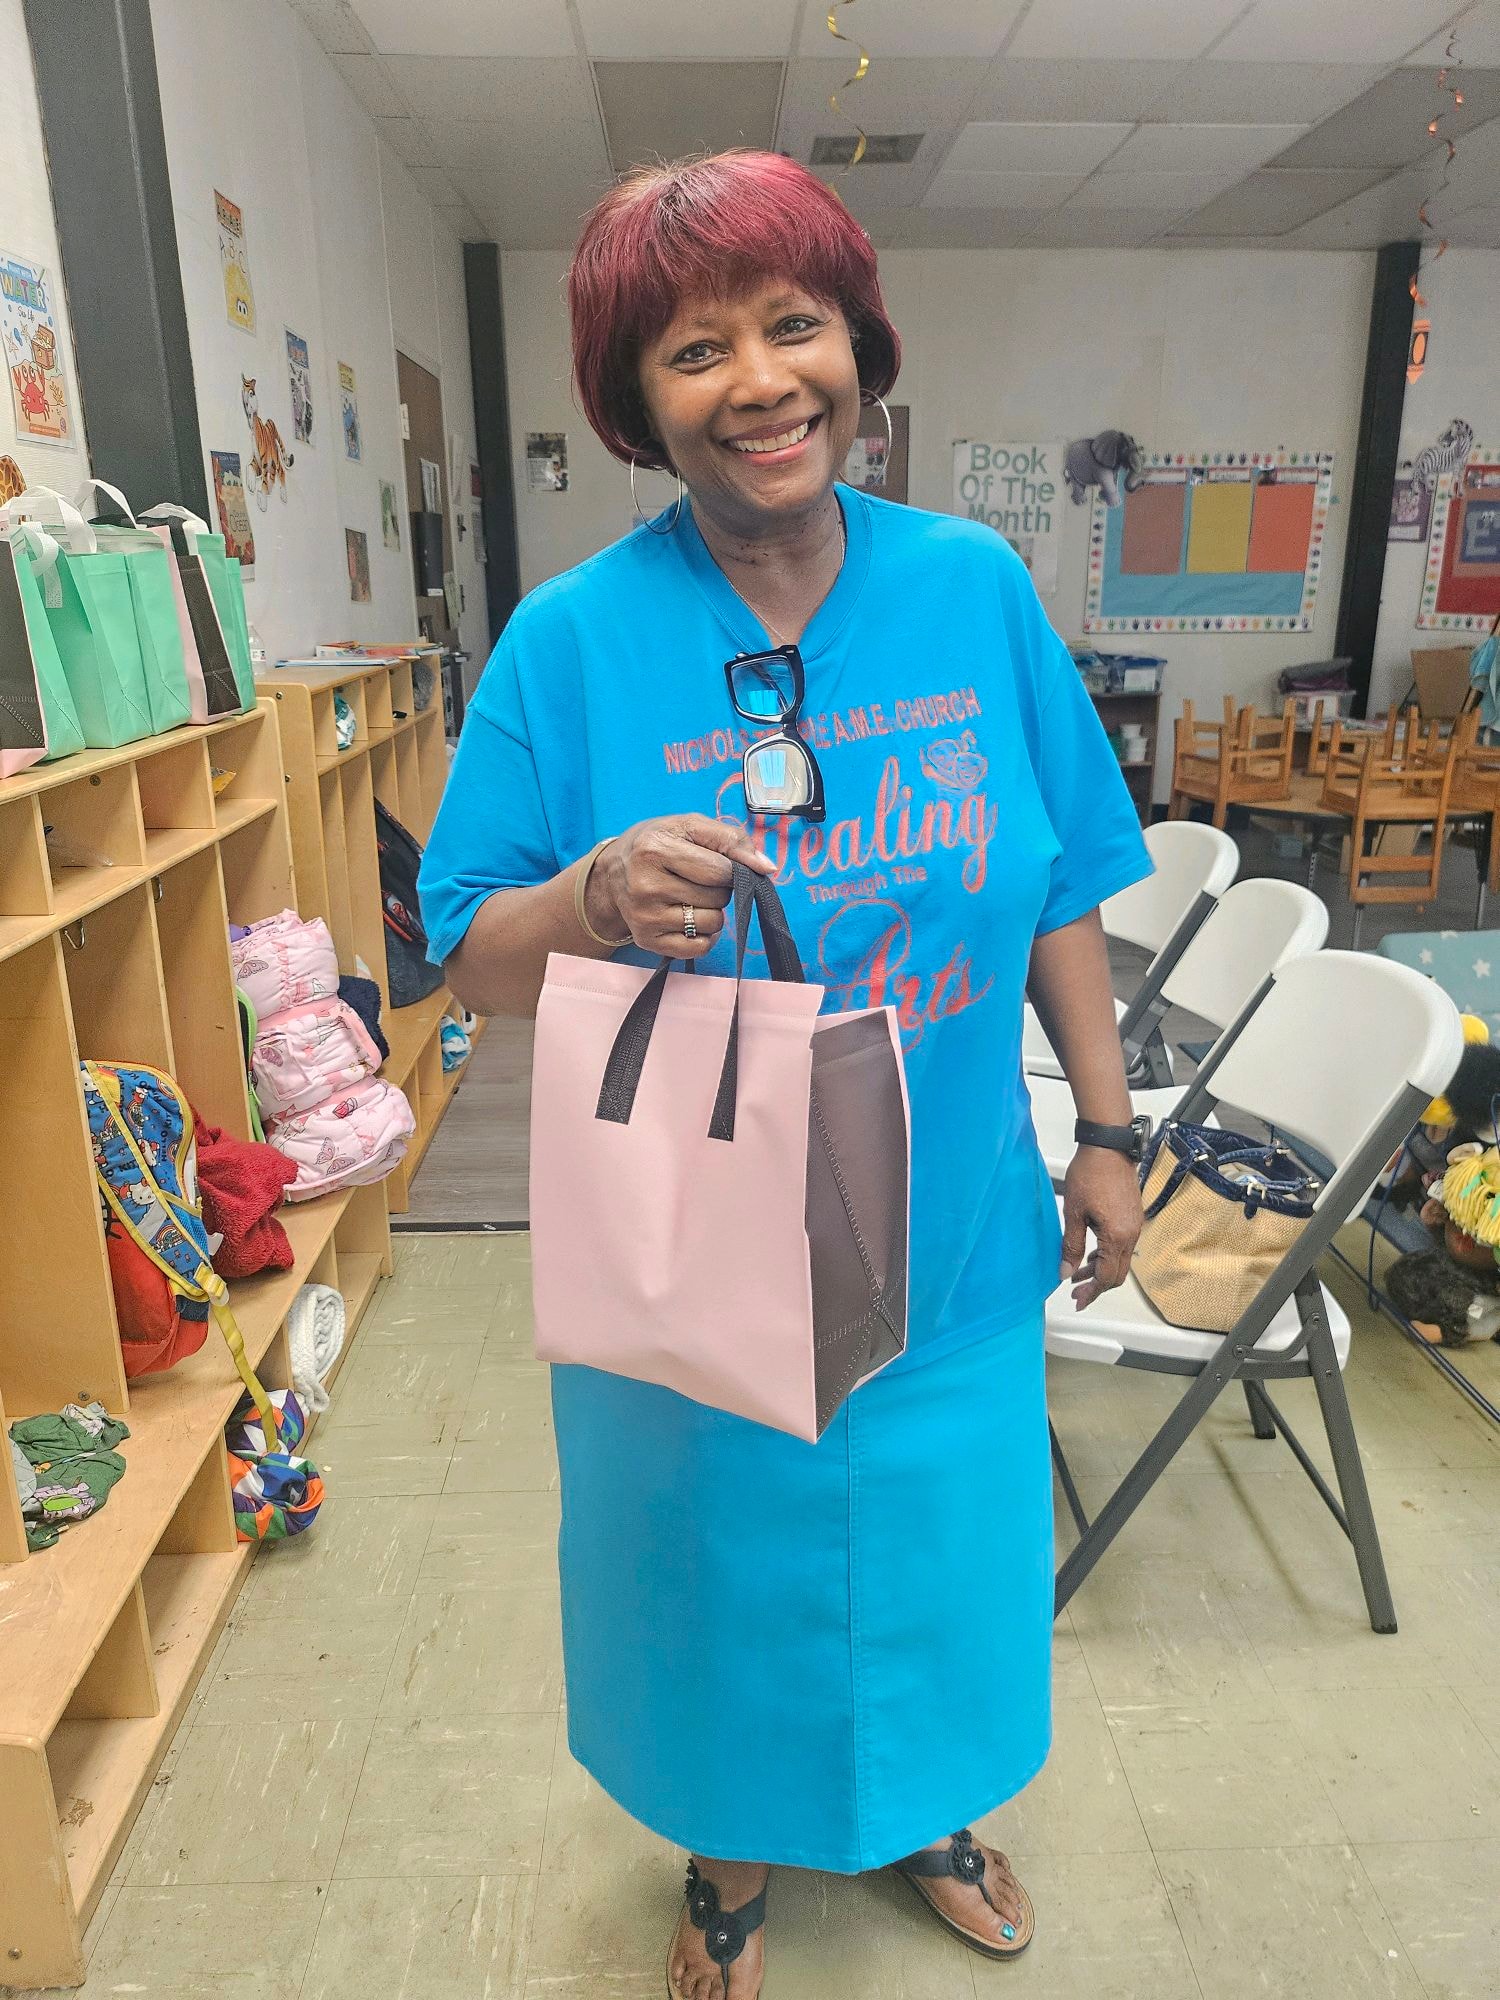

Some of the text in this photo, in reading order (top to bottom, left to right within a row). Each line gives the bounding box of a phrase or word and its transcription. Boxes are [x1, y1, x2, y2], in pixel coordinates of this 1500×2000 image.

[0, 271, 46, 309] WATER
[970, 444, 1048, 474] Book
[960, 474, 1056, 504] Of The
[968, 503, 1051, 533] Month
[895, 686, 981, 732] CHURCH
[805, 865, 928, 904] Through The
[817, 897, 995, 1054] Arts
